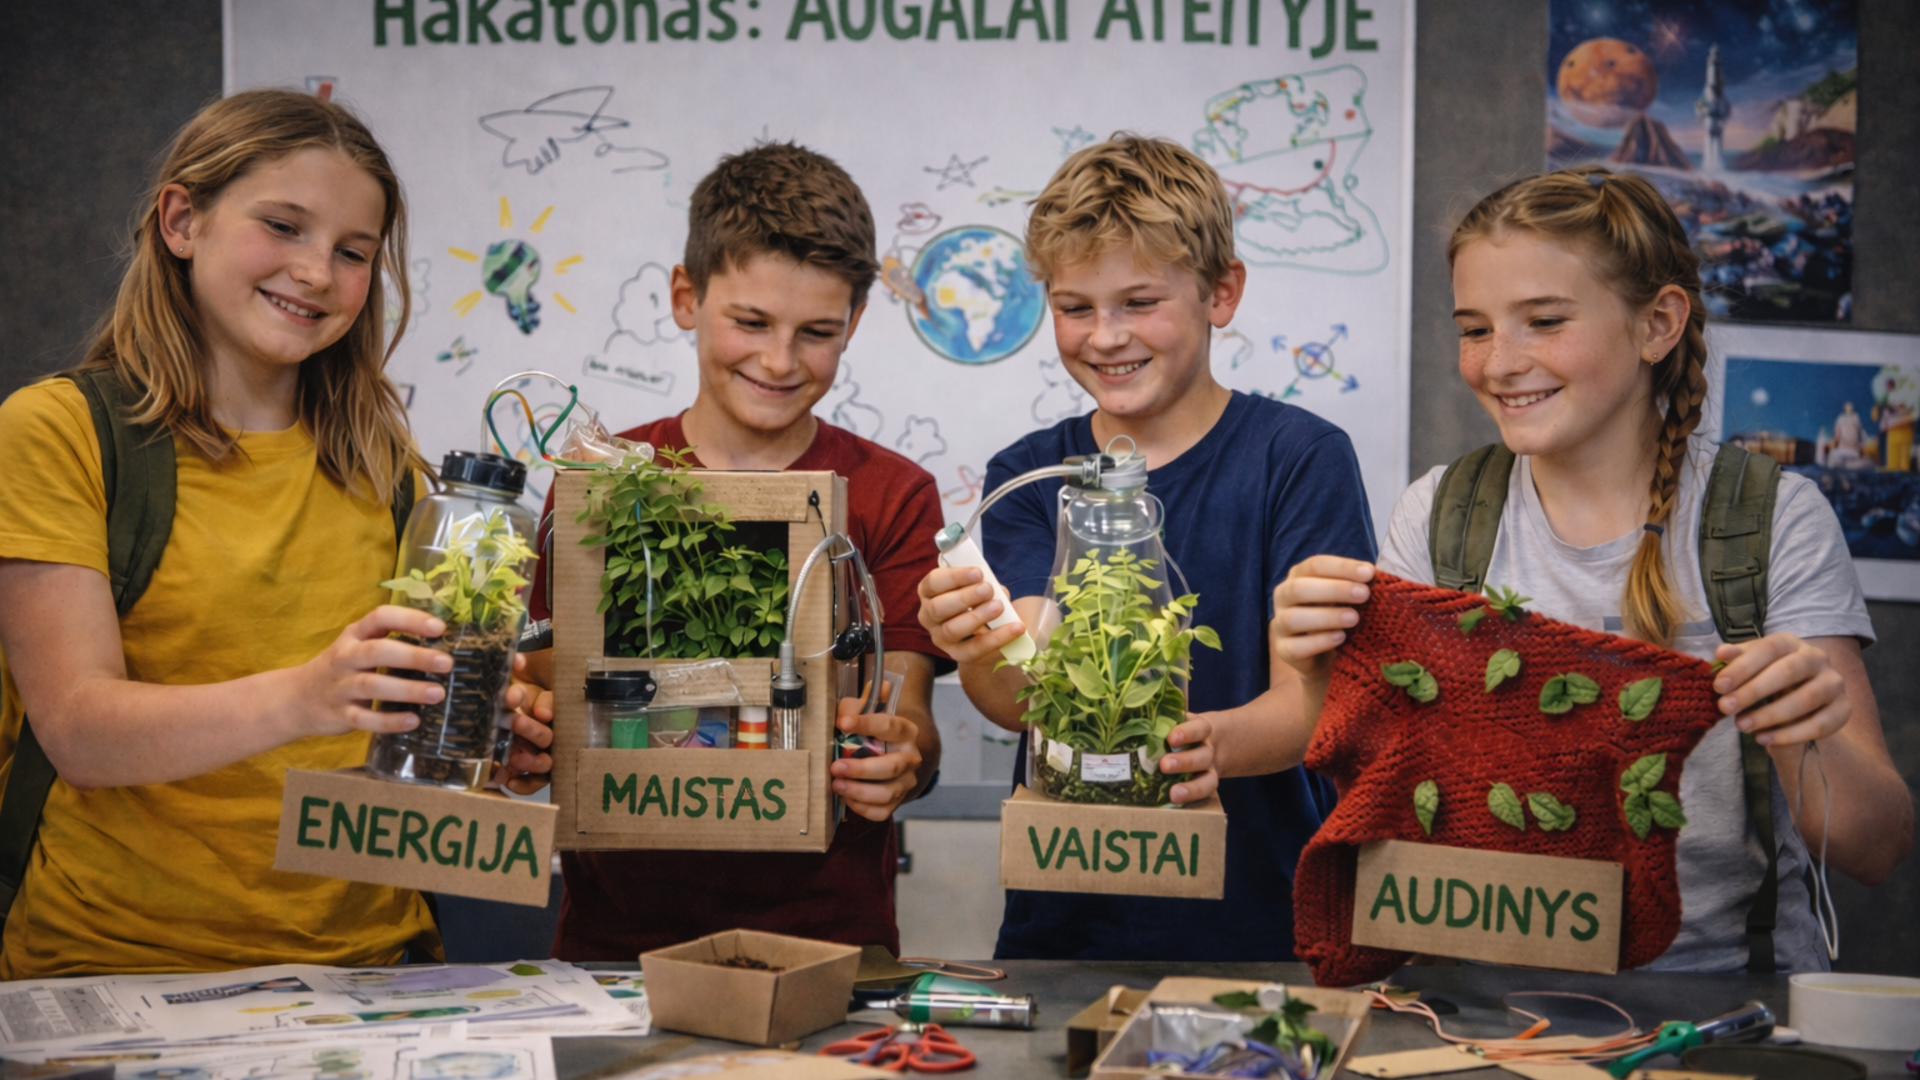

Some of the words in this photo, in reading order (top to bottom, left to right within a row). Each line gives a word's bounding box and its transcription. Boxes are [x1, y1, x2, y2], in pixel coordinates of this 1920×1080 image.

[374, 0, 761, 46] Hakatonas:
[786, 0, 1068, 42] AUGALAI
[602, 772, 787, 821] MAISTAS
[297, 796, 539, 877] ENERGIJA
[1028, 825, 1199, 877] VAISTAI
[1370, 873, 1599, 941] AUDINYS
